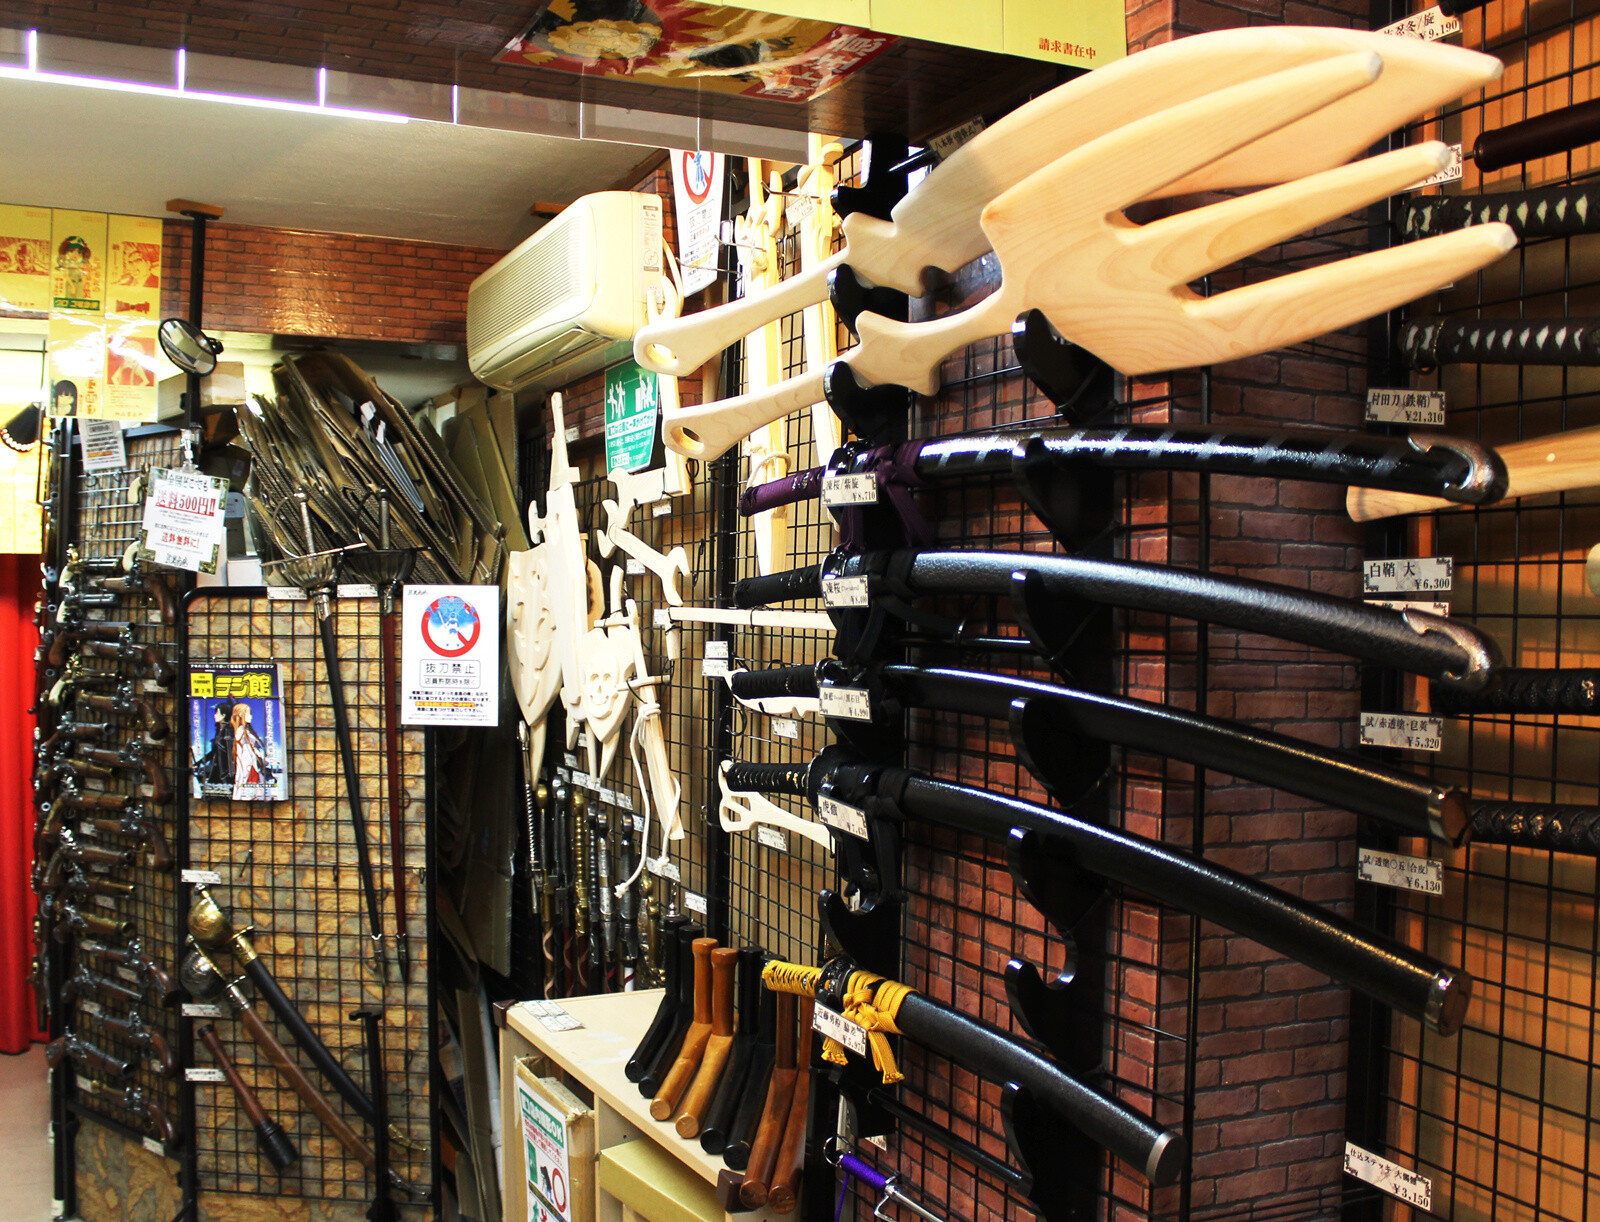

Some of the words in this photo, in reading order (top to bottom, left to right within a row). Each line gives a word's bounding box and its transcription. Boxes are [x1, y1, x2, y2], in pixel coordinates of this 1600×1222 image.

[1038, 37, 1096, 60] 請求書在中
[1405, 410, 1443, 423] ¥21,310
[1370, 562, 1395, 578] 白鞘
[1403, 561, 1416, 577] 大
[1415, 578, 1450, 590] ¥6,300
[425, 662, 475, 675] 抜刀禁止
[215, 672, 272, 698] ラジ館
[1407, 736, 1440, 750] ¥5,320
[1406, 876, 1441, 893] ¥6,130
[1394, 1183, 1429, 1207] ¥3,150
